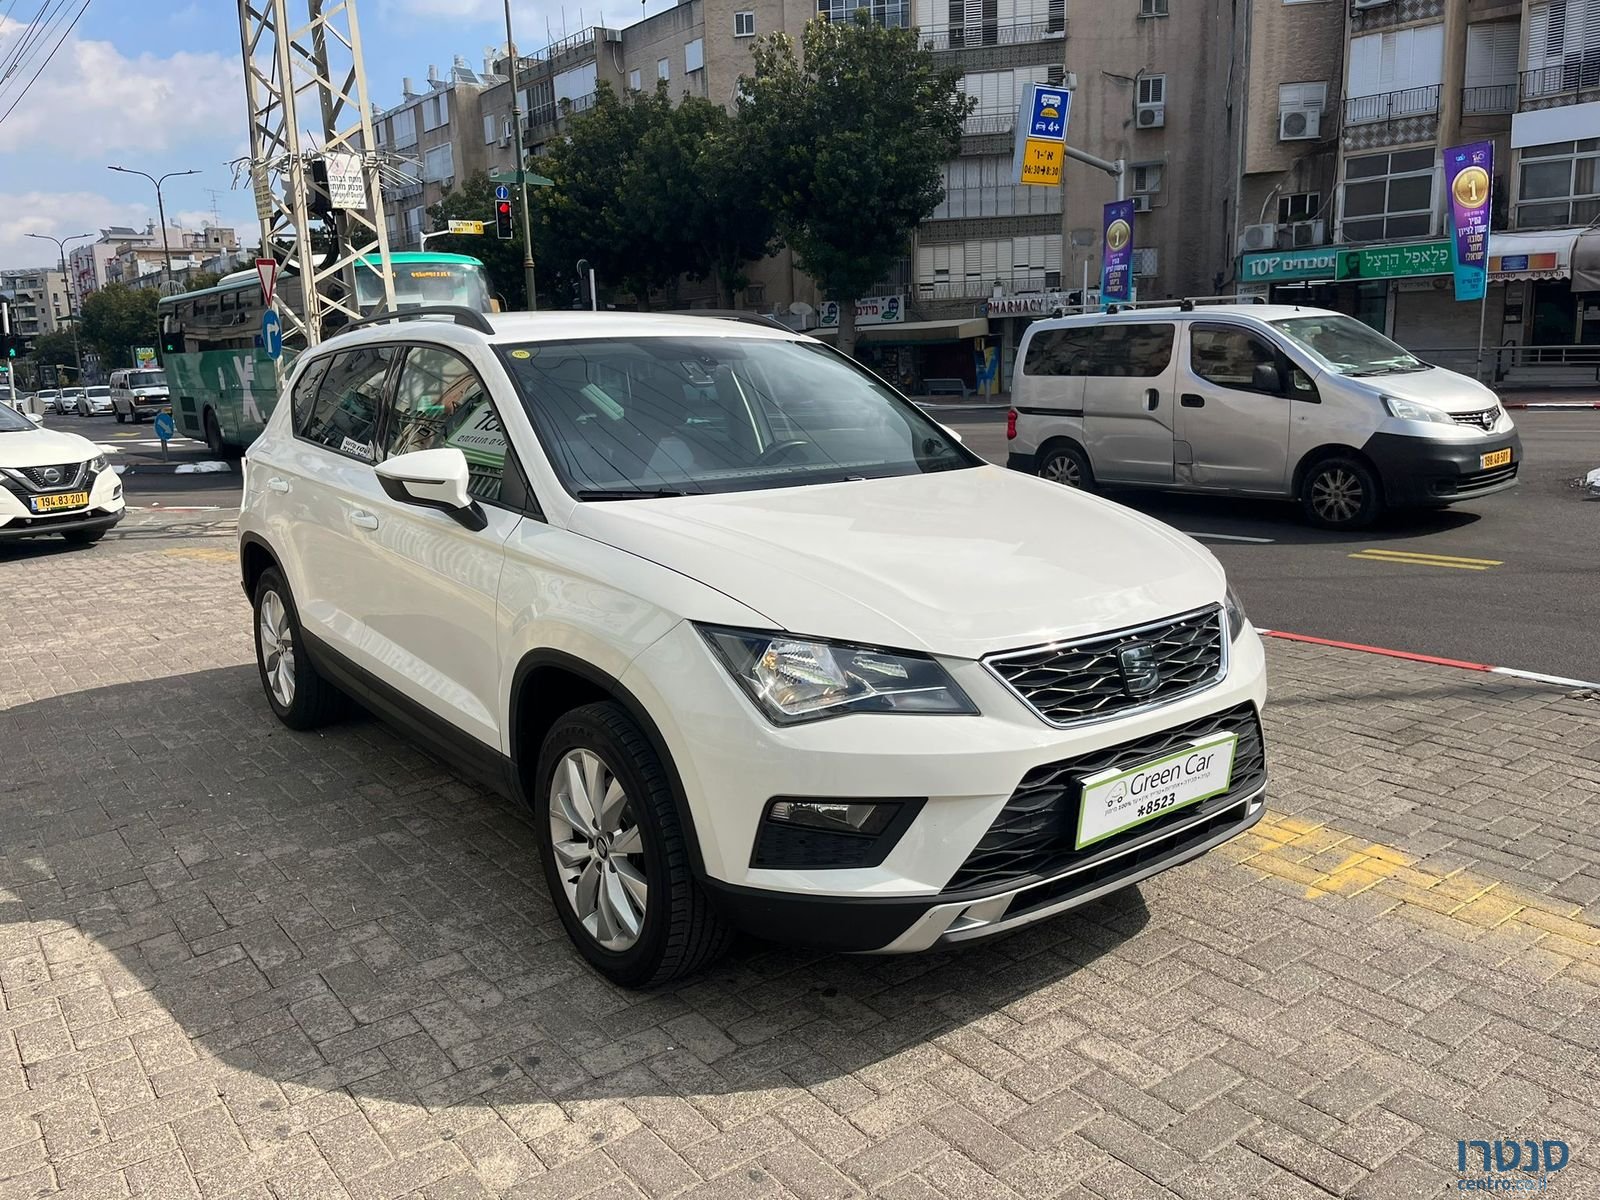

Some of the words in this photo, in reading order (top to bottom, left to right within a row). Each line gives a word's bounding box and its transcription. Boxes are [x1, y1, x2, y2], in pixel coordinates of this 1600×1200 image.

[1248, 256, 1281, 276] TOP
[988, 298, 1043, 313] PHARMACY
[1130, 765, 1182, 795] Green
[1185, 752, 1214, 776] Car
